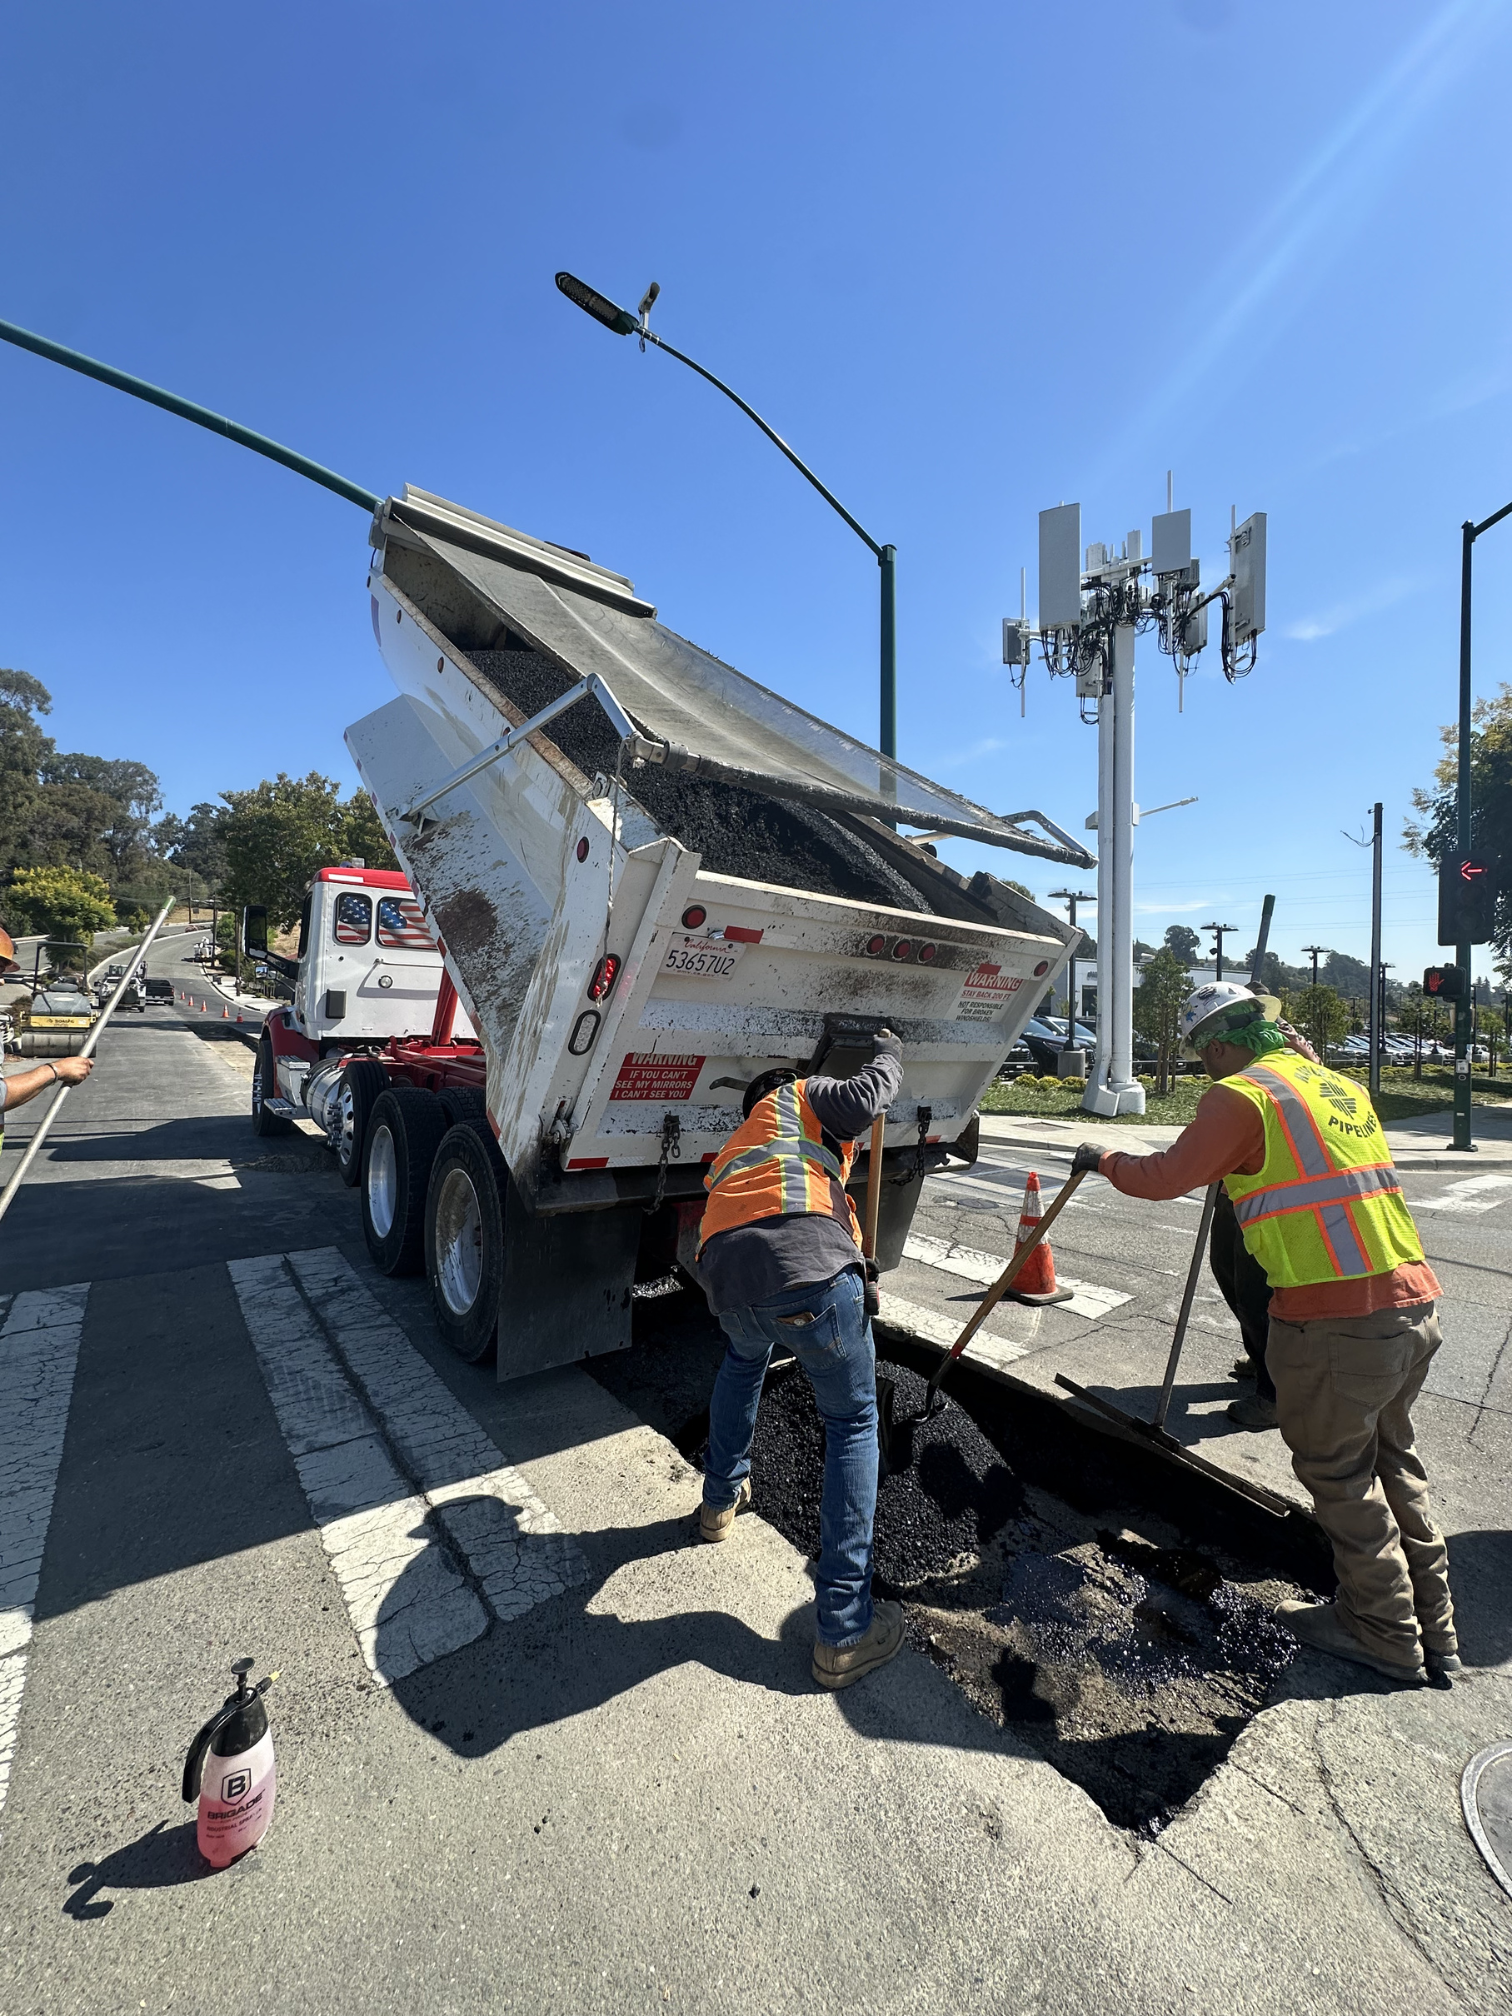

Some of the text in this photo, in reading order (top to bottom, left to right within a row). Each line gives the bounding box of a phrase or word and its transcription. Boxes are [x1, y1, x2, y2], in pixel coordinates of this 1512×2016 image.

[684, 939, 731, 954] California
[666, 949, 735, 975] 53657U2
[968, 972, 1021, 990] WARNING
[976, 991, 991, 999] BACK
[969, 1001, 1004, 1010] RESPONSIBLE
[631, 1053, 698, 1066] WARNING
[629, 1070, 688, 1079] IF YOU CAN'T
[615, 1080, 693, 1089] SEE MY MIRRORS
[614, 1090, 687, 1098] I CAN'T SEE YOU
[228, 1775, 246, 1799] B
[207, 1792, 263, 1820] BRIGADE
